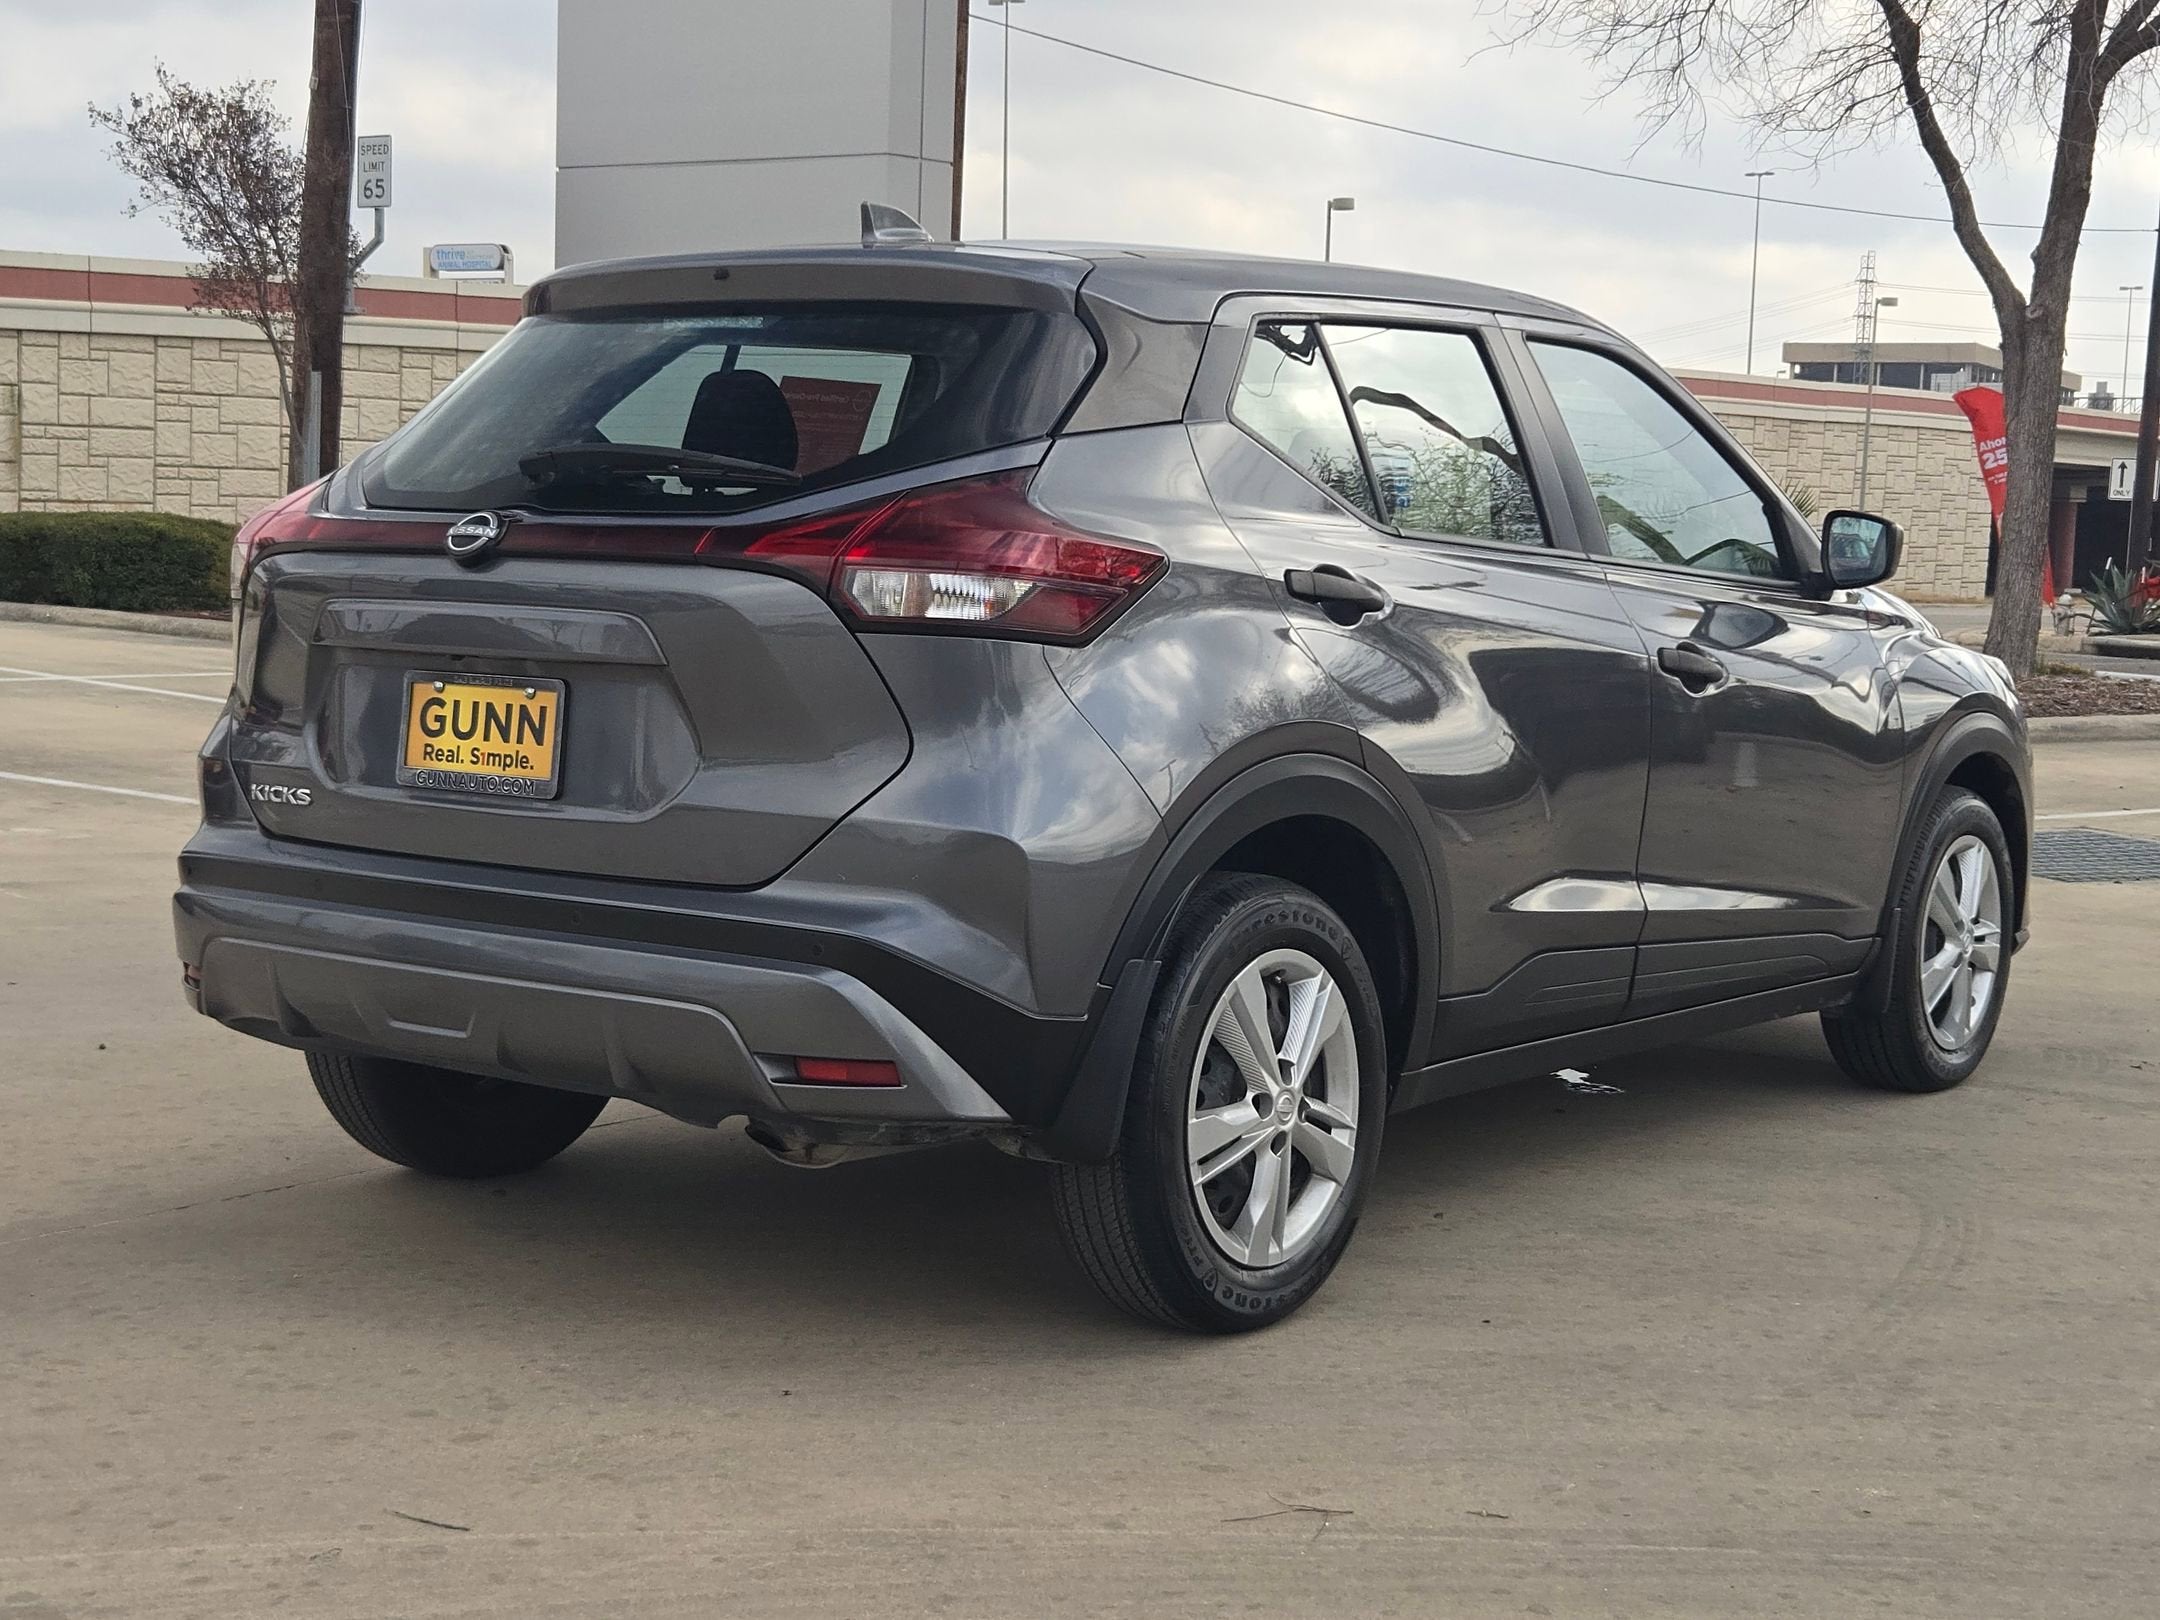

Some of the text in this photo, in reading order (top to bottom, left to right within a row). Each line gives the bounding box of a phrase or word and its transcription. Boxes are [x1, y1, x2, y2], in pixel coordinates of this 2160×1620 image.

[360, 144, 389, 156] SPEED
[363, 161, 385, 173] LIMIT
[363, 178, 385, 199] 65
[436, 248, 465, 260] thrive
[1979, 436, 2007, 453] Ahor
[2112, 489, 2131, 497] ONLY
[420, 697, 548, 746] GUNN
[423, 743, 464, 764] Real.
[416, 770, 536, 795] GUNNAUTO.COM
[251, 784, 311, 805] KICKS
[1235, 909, 1340, 941] restone
